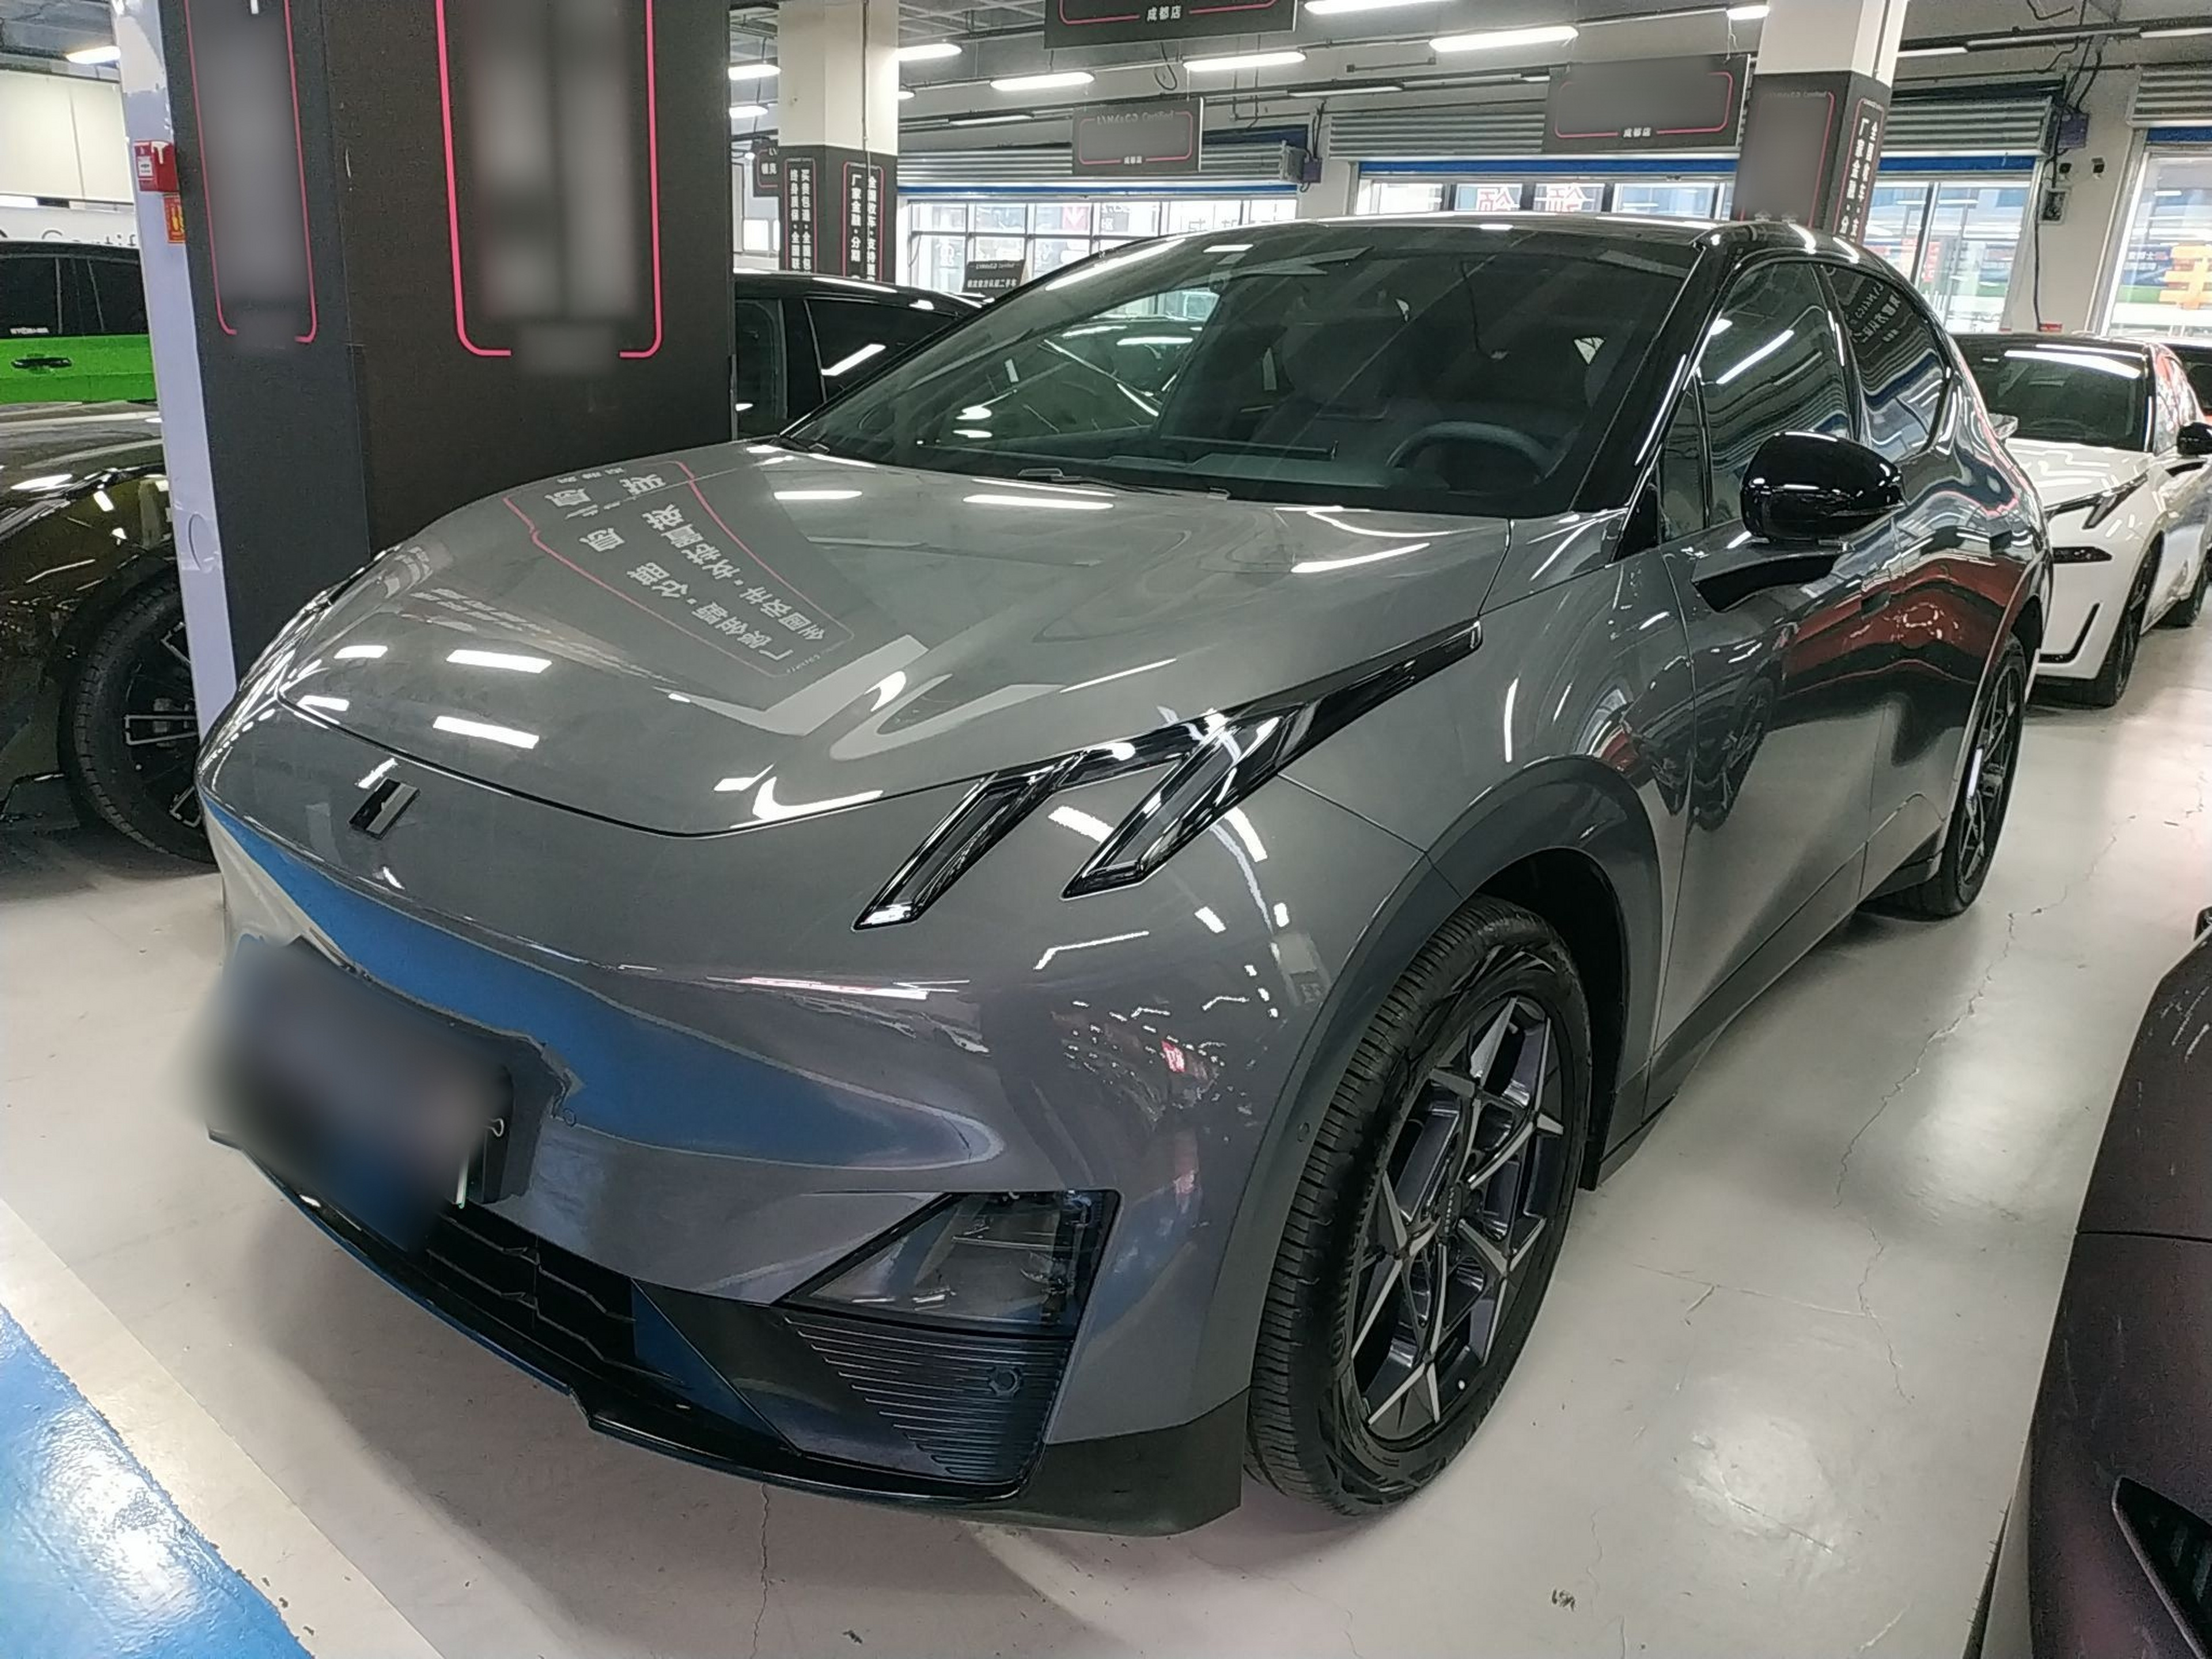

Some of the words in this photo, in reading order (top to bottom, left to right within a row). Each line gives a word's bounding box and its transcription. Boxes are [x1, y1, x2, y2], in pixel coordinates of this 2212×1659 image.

[1147, 5, 1181, 22] 成都店
[1623, 127, 1652, 138] 成都店
